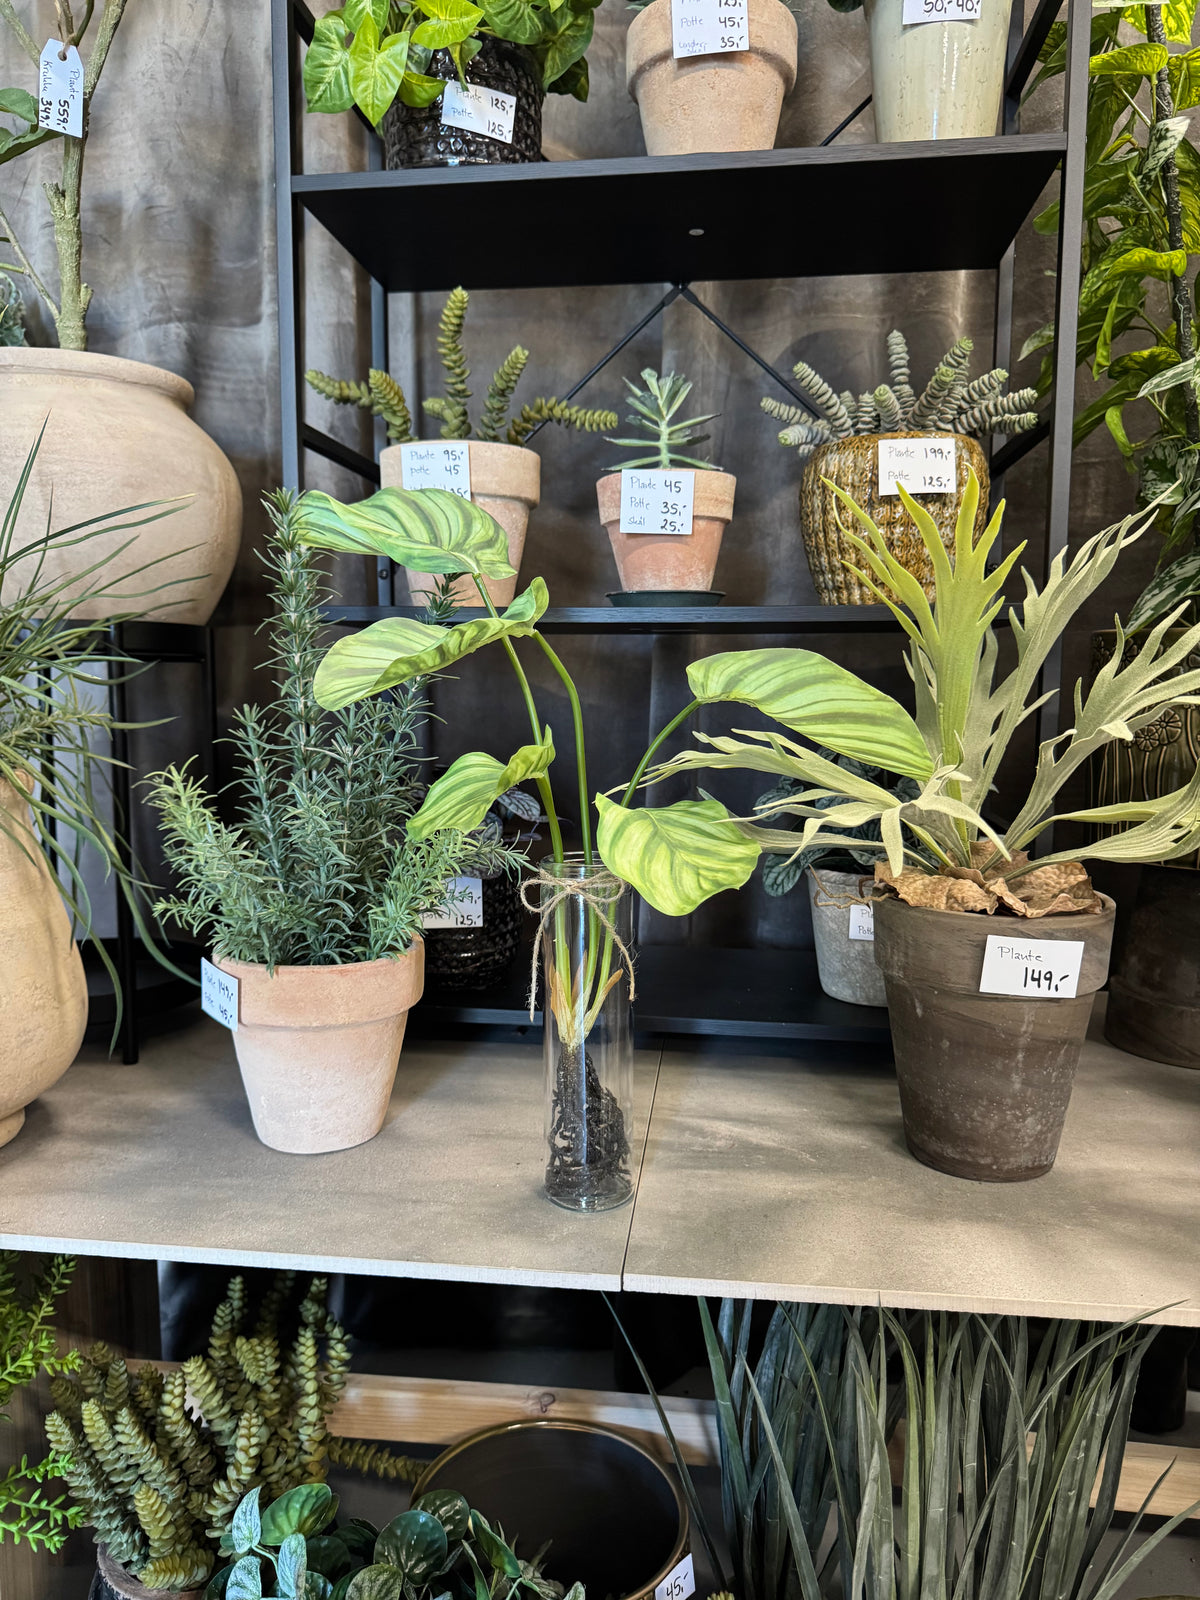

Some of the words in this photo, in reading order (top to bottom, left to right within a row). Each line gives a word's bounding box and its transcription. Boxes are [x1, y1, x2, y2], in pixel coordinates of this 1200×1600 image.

[680, 16, 704, 28] Potte
[718, 16, 744, 28] 45,-
[720, 36, 744, 48] 35,-
[69, 68, 81, 100] Plante
[56, 99, 70, 131] 559,-
[490, 96, 513, 116] 125,-
[450, 107, 473, 119] Potte
[487, 120, 512, 140] 125,-
[888, 446, 916, 459] Plante
[923, 447, 951, 461] 199,-
[664, 479, 683, 493] 45
[888, 470, 911, 481] Potte
[922, 475, 951, 488] 125,-
[630, 496, 651, 510] Potte
[660, 501, 687, 516] 35,-
[997, 946, 1044, 963] Plante
[1023, 966, 1070, 992] 149,-
